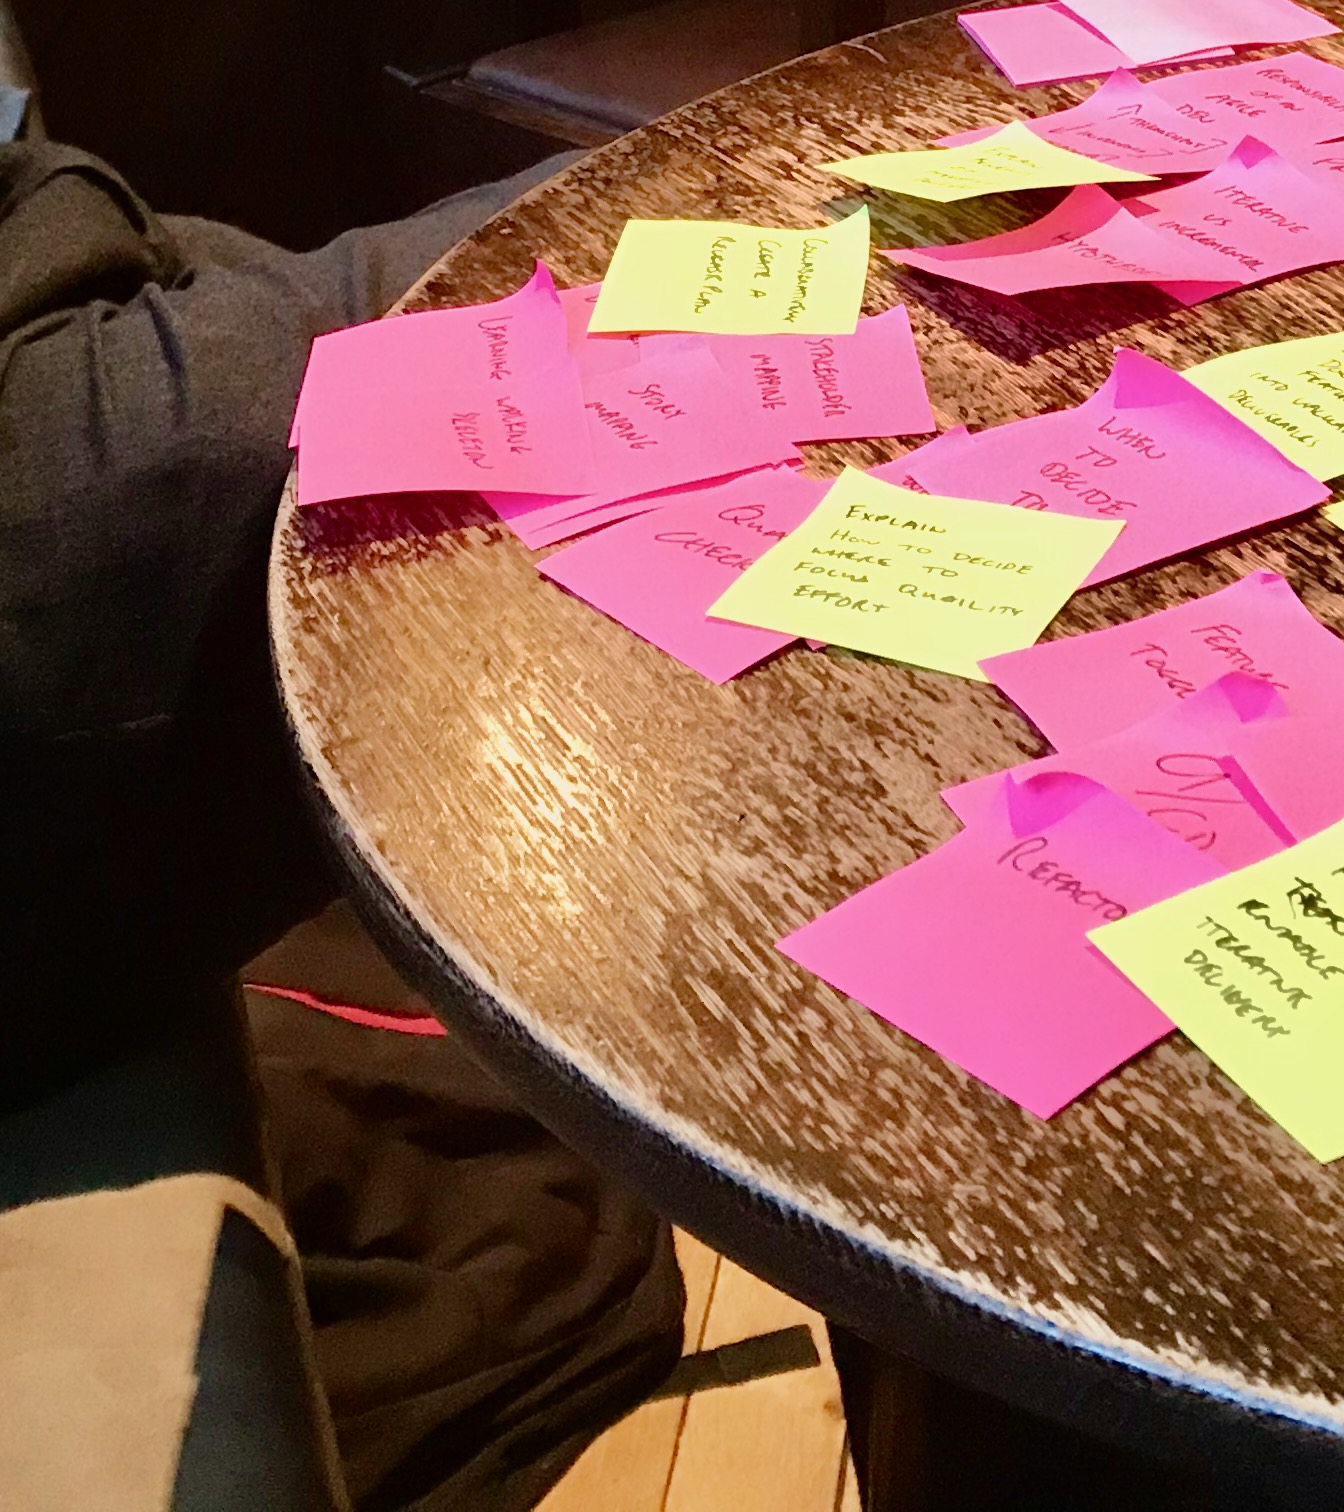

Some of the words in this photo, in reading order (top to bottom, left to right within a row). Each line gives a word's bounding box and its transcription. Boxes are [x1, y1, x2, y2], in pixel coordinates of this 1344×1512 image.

[1213, 185, 1309, 234] ITERATIVE
[628, 383, 687, 420] STORY
[1075, 445, 1118, 468] TO
[1097, 416, 1167, 460] WHEN
[1039, 461, 1138, 516] DECIDE
[845, 505, 947, 534] EXPLAIN
[810, 547, 893, 567] WHERE
[922, 565, 960, 579] TO
[830, 529, 880, 546] HOW
[898, 543, 933, 554] TO
[953, 551, 1035, 576] DECIDE
[794, 561, 869, 583] FOCUS
[793, 584, 891, 615] EFFORT
[996, 836, 1127, 921] REFACTO
